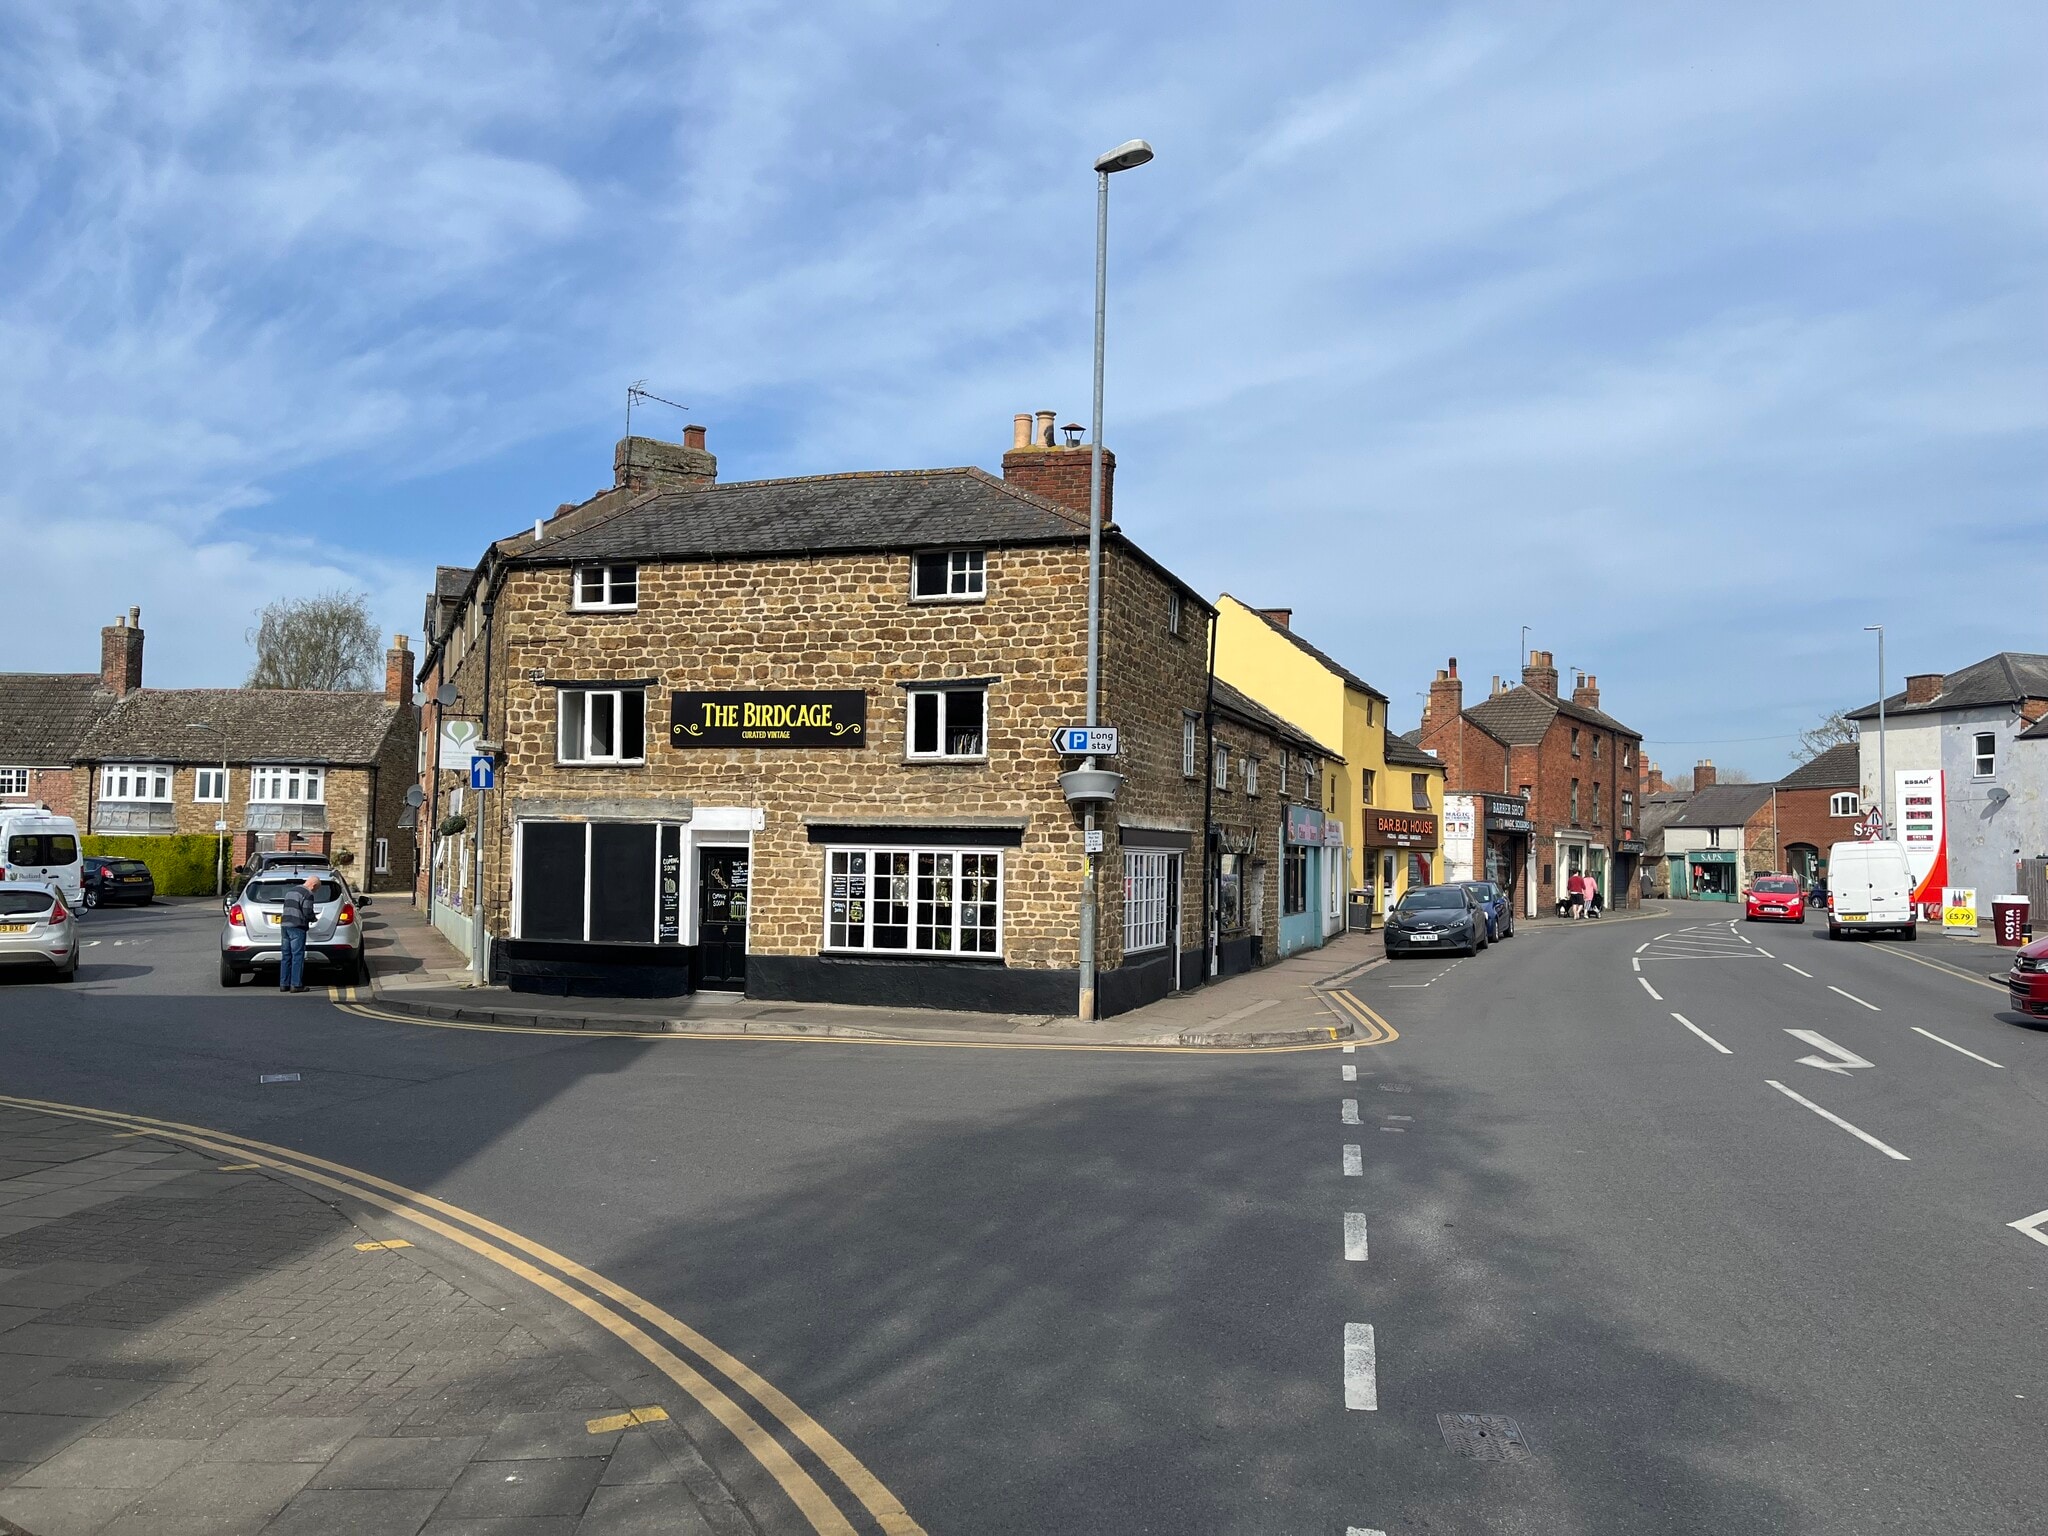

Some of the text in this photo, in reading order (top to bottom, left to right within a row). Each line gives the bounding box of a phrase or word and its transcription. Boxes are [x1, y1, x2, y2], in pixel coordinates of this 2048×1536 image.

[702, 702, 833, 727] THE BIRDCAGE
[741, 731, 791, 739] CURATED VINTAGE
[1073, 733, 1085, 748] P
[1090, 731, 1114, 741] Long
[1091, 741, 1112, 751] stay
[1492, 802, 1524, 816] BARBER SHOP
[1378, 818, 1433, 834] BAR.B.Q HOUSE
[1949, 913, 1971, 921] £5.79
[2005, 909, 2015, 941] COSTA
